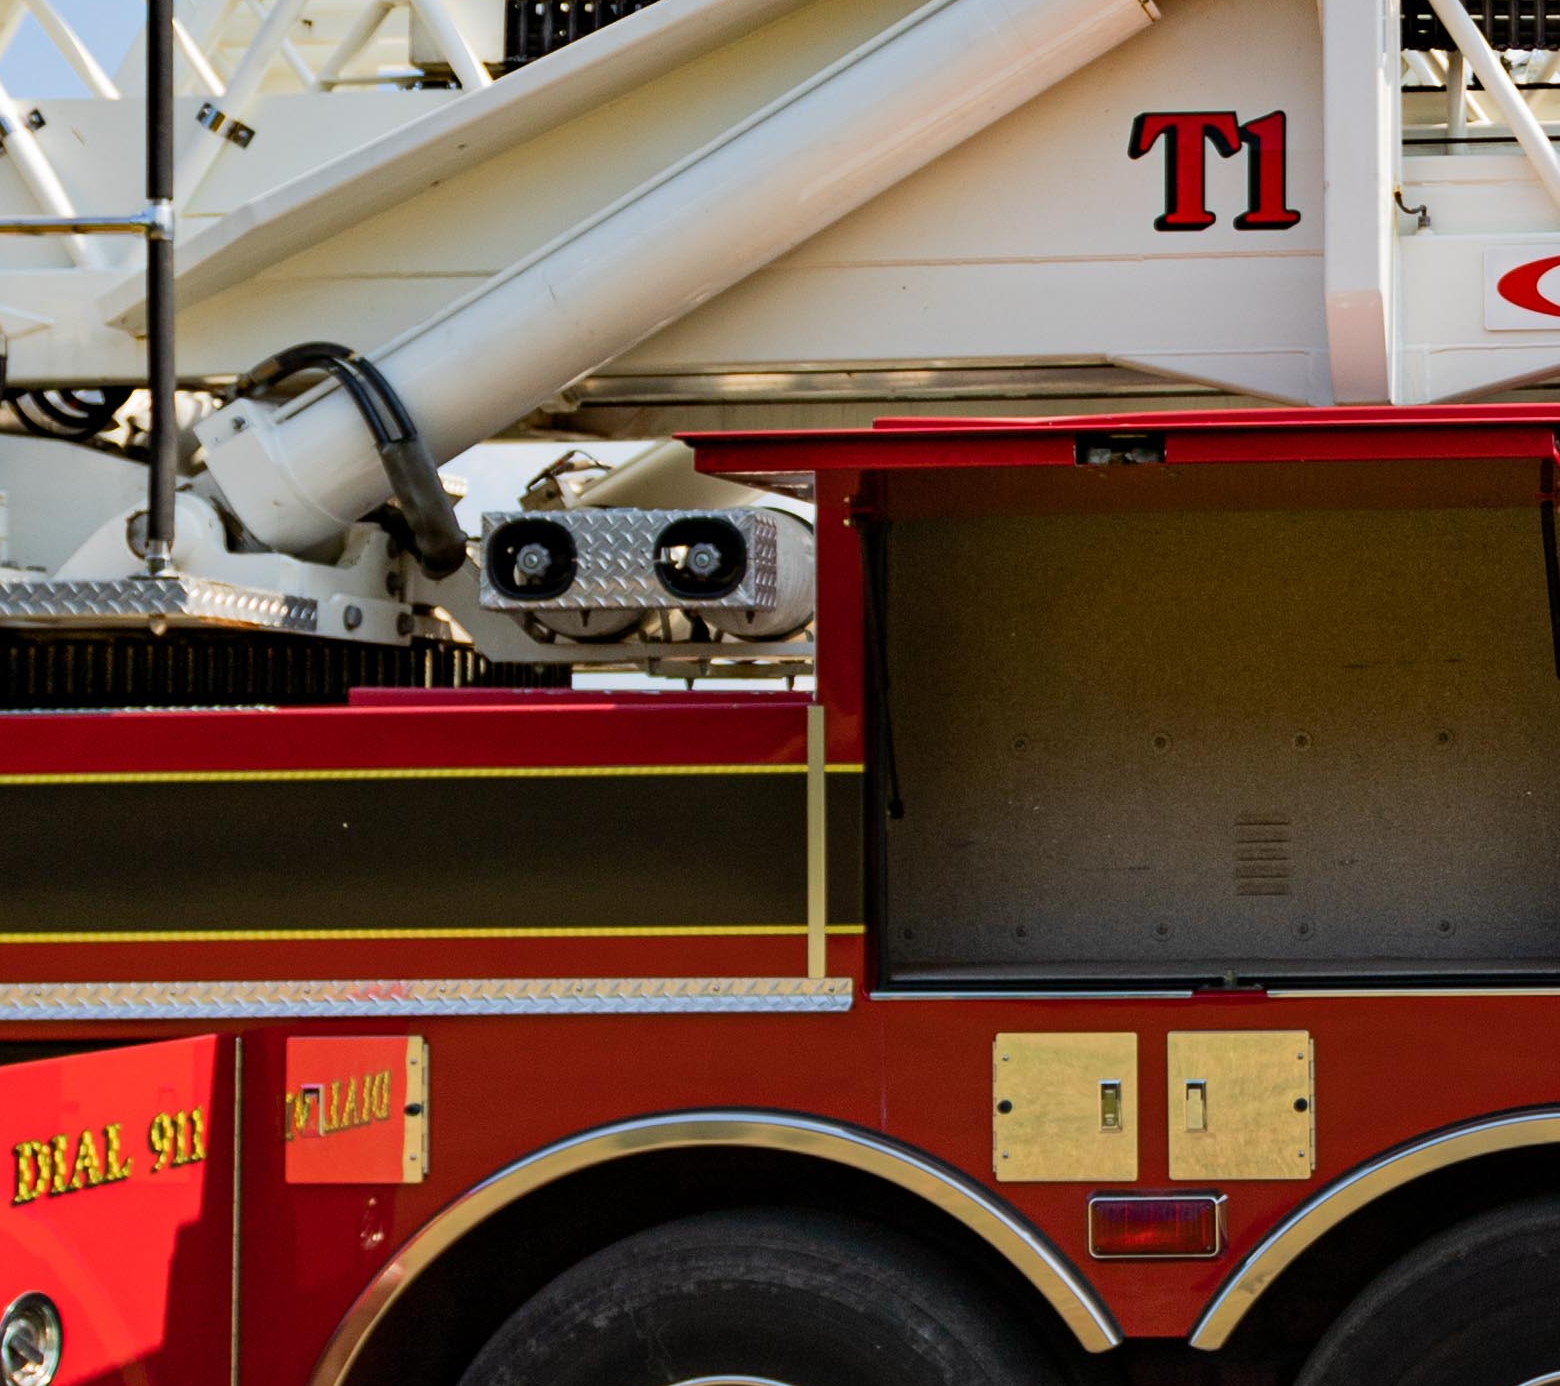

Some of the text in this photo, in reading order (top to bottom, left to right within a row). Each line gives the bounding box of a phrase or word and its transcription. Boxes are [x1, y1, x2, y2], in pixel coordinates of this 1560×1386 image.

[1128, 110, 1301, 231] T1
[11, 1123, 133, 1207] DIAL
[148, 1105, 207, 1173] 911
